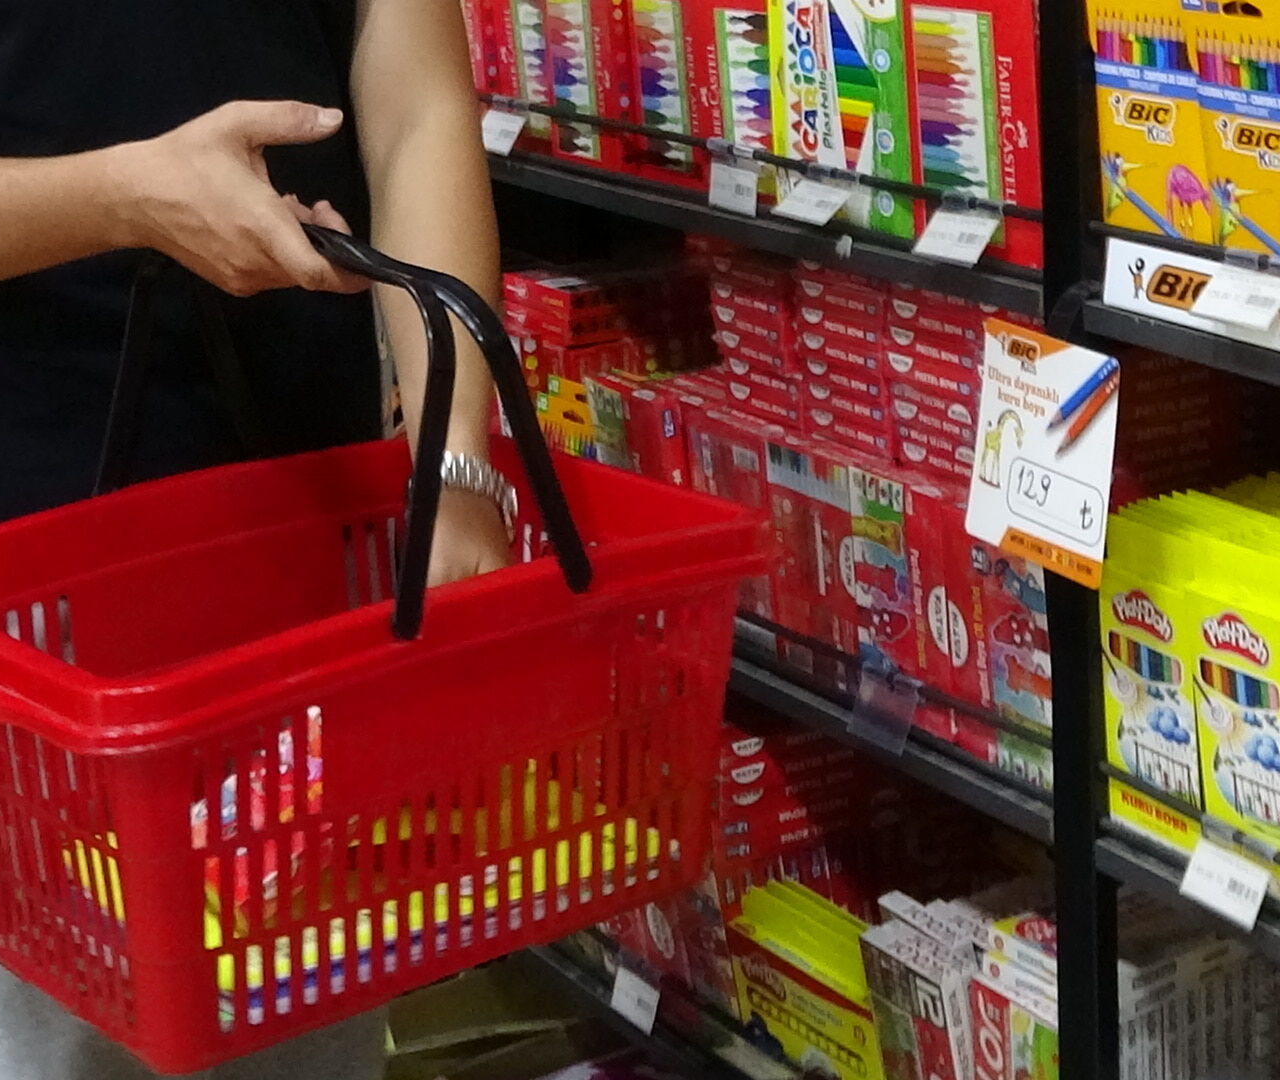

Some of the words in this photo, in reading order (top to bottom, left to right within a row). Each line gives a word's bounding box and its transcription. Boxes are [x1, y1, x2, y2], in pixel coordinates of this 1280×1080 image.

[707, 42, 722, 138] BER-CASTELL
[996, 54, 1018, 206] FABER-CASTELL
[987, 367, 1013, 388] Ultra
[1014, 375, 1060, 405] dayanıklı
[997, 387, 1021, 407] kuru
[1022, 396, 1046, 417] boya
[1017, 465, 1052, 508] 129
